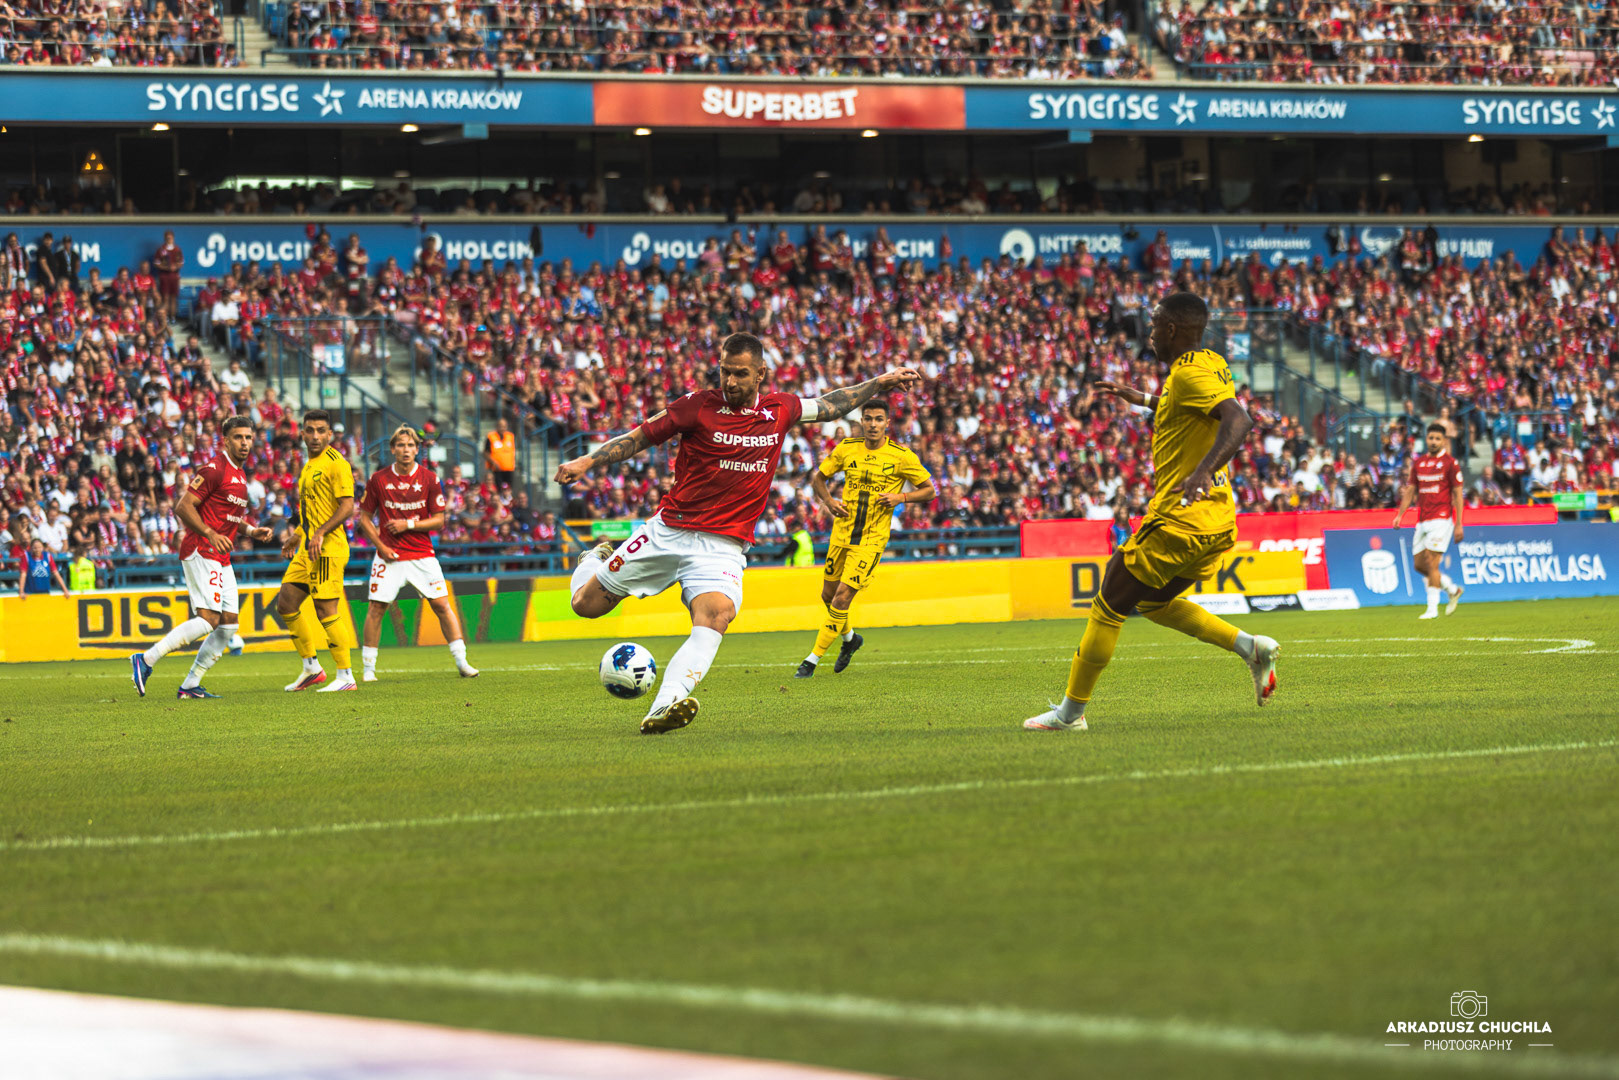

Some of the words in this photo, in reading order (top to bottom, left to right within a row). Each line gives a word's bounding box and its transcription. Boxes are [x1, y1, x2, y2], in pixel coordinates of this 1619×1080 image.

[357, 88, 430, 109] ARENA
[430, 86, 522, 110] KRAKÓW
[701, 85, 858, 121] SUPERBET
[1207, 98, 1270, 118] ARENA
[1269, 96, 1347, 119] KRAKÓW
[852, 239, 935, 258] HCIM
[712, 431, 780, 448] SUPERBET
[385, 499, 426, 511] SUPERBET
[626, 534, 649, 554] 6
[1458, 541, 1485, 558] PKO
[1485, 540, 1517, 557] Bank
[1516, 538, 1554, 556] Polski
[1460, 553, 1607, 585] EKSTRAKLASA
